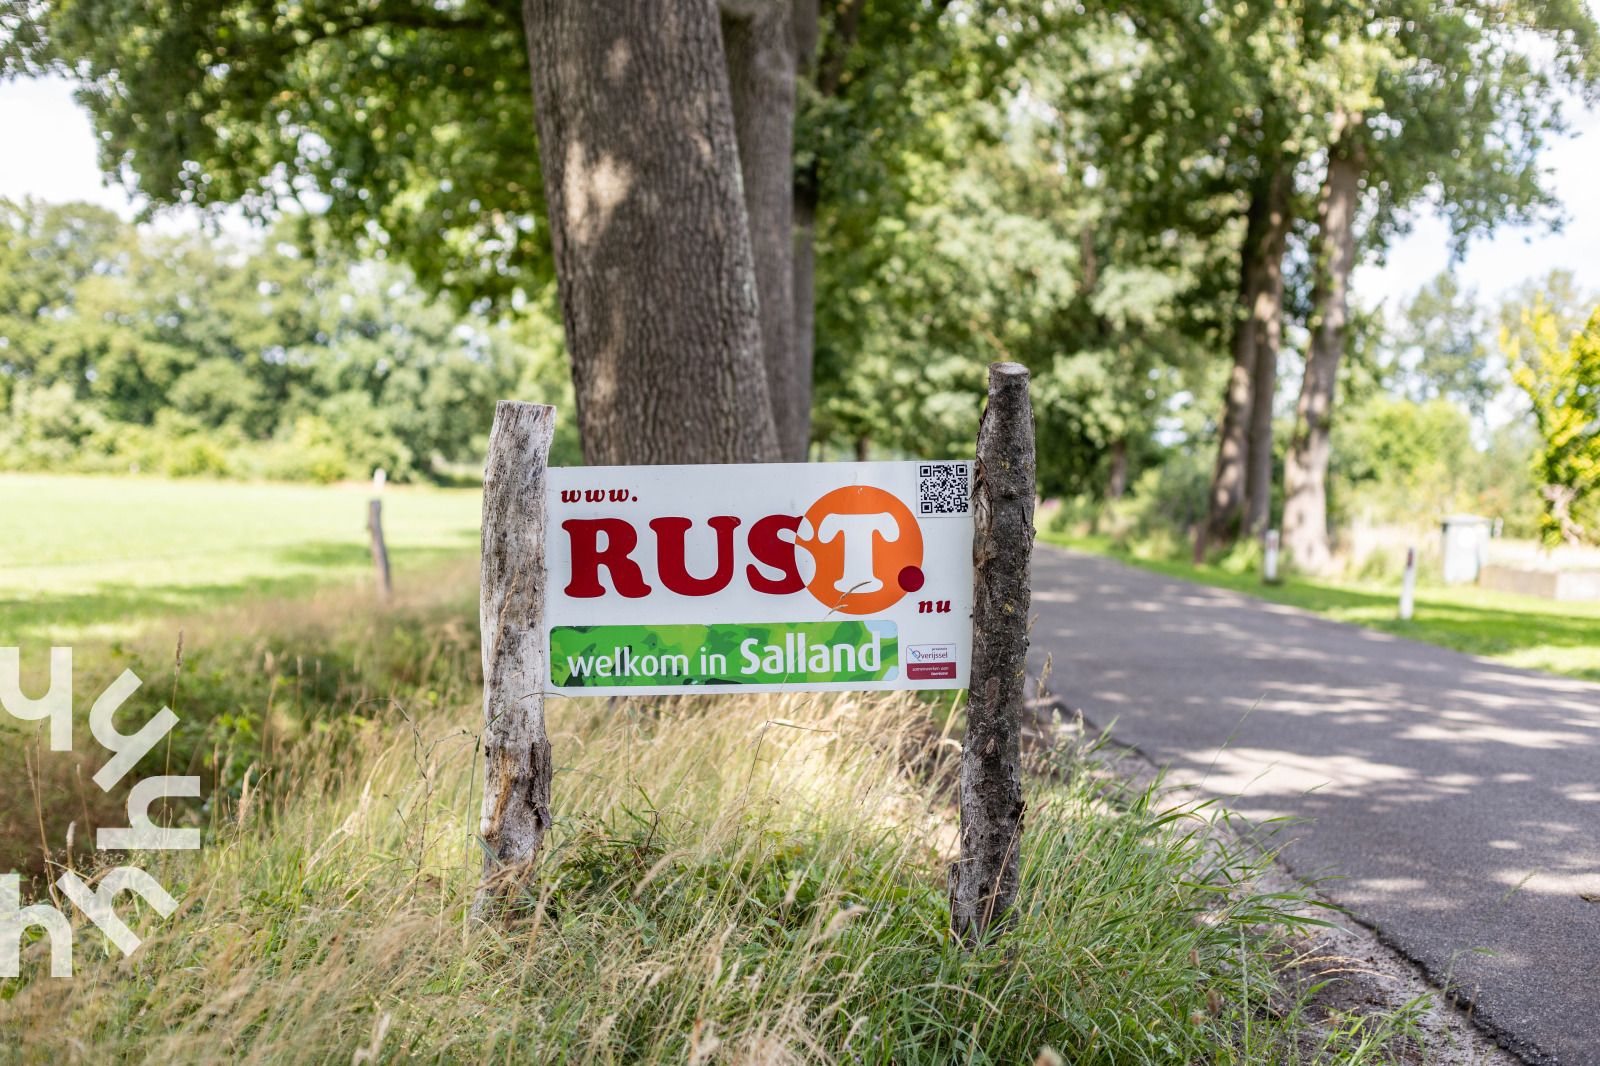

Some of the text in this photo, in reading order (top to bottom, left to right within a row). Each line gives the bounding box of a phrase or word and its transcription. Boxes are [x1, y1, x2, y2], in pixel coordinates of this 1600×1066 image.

[561, 488, 638, 503] www.
[567, 631, 881, 677] welkom in Salland
